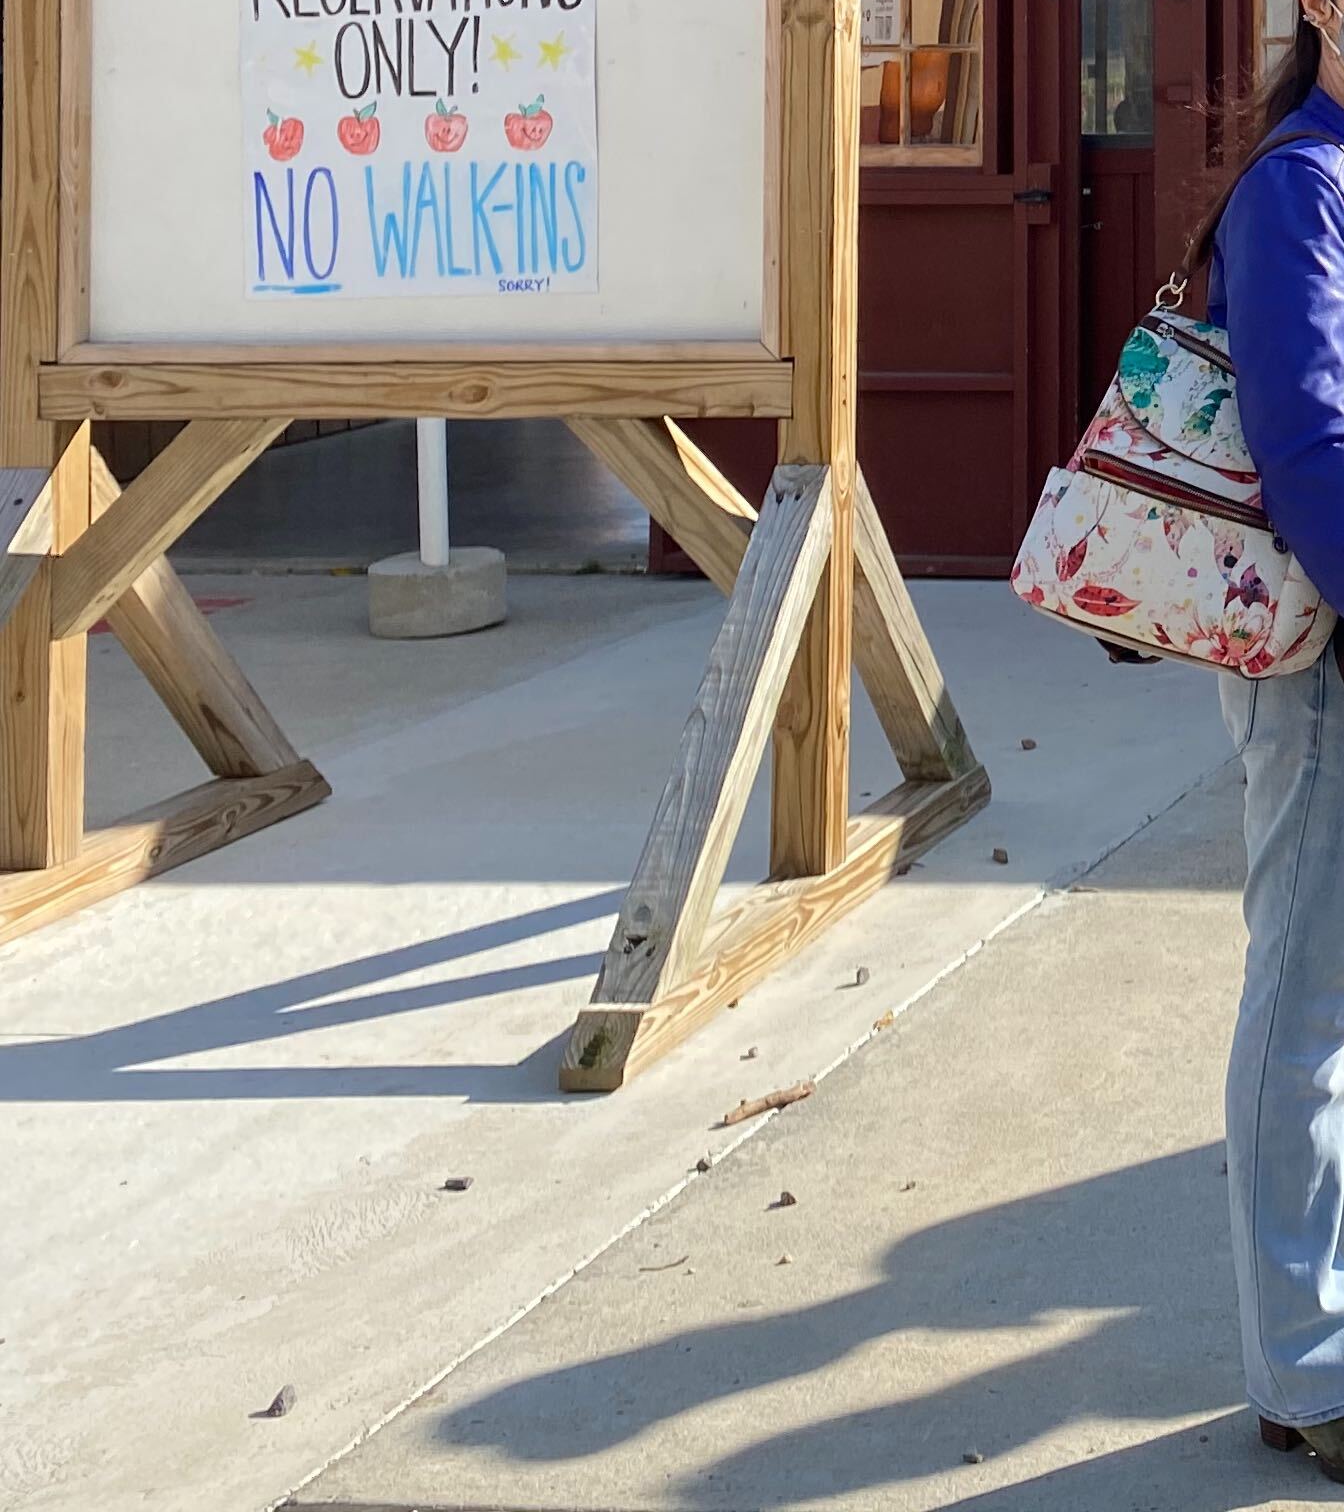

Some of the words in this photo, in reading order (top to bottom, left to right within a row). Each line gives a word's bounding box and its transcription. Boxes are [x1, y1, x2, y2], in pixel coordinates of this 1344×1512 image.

[333, 15, 481, 99] ONLY!
[252, 166, 339, 281] NO
[364, 159, 586, 278] WALK-INS
[498, 277, 550, 293] SORRY!
